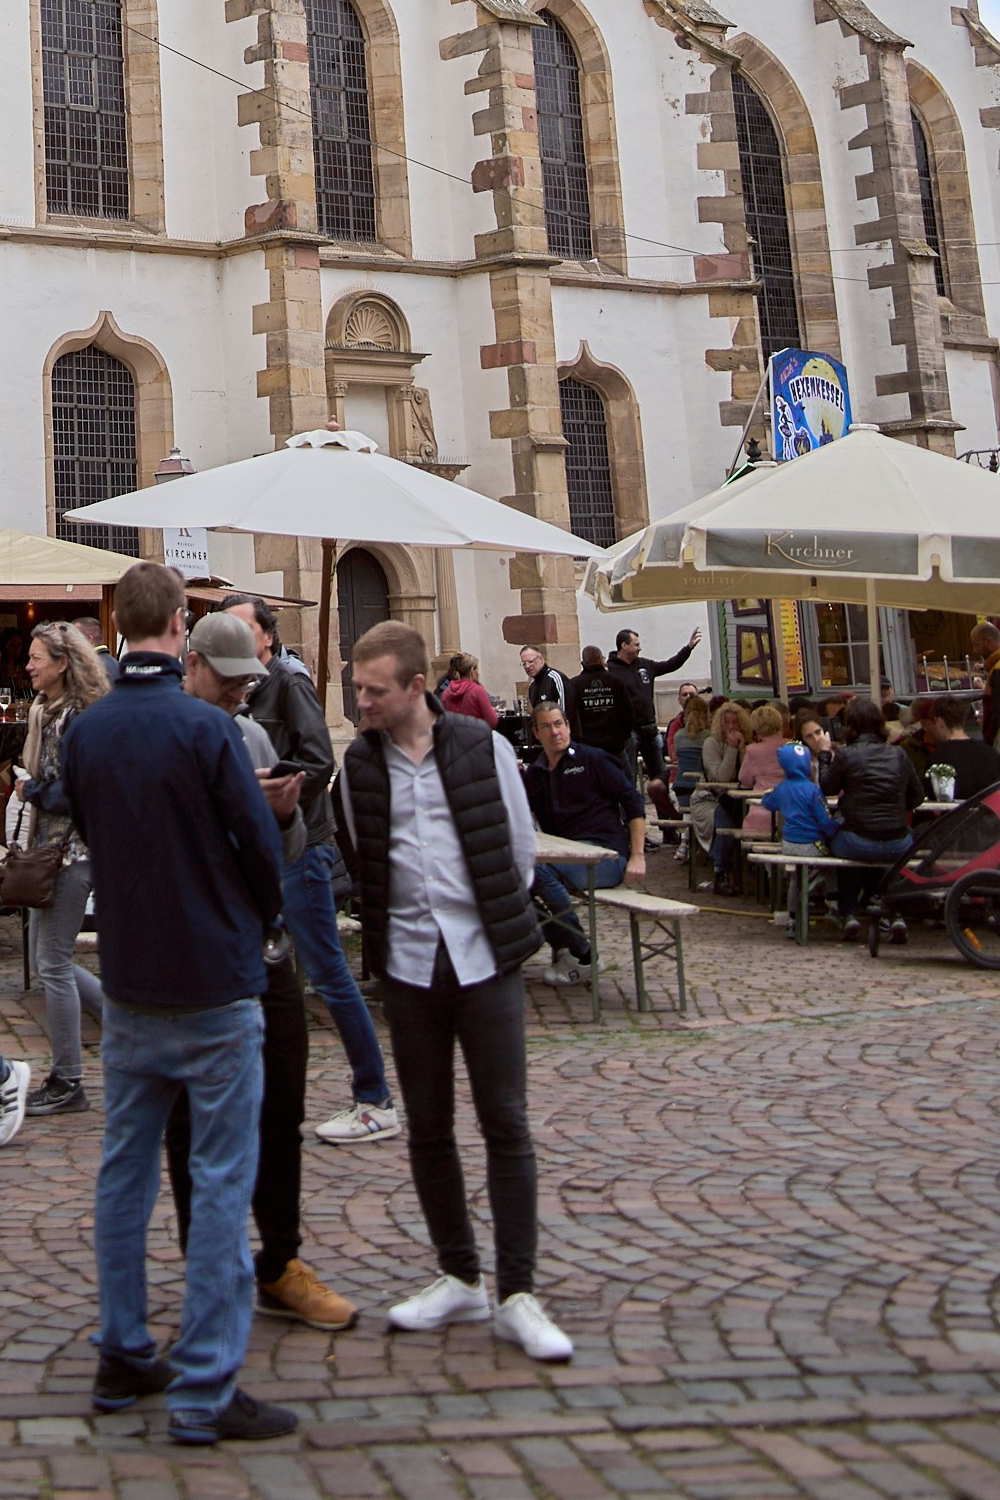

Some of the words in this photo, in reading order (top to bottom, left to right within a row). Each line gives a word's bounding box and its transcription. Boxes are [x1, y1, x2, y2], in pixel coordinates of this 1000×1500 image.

[789, 376, 845, 412] HEXENKESSEL
[165, 548, 208, 561] KIRCHNER
[765, 530, 856, 564] Kirchner
